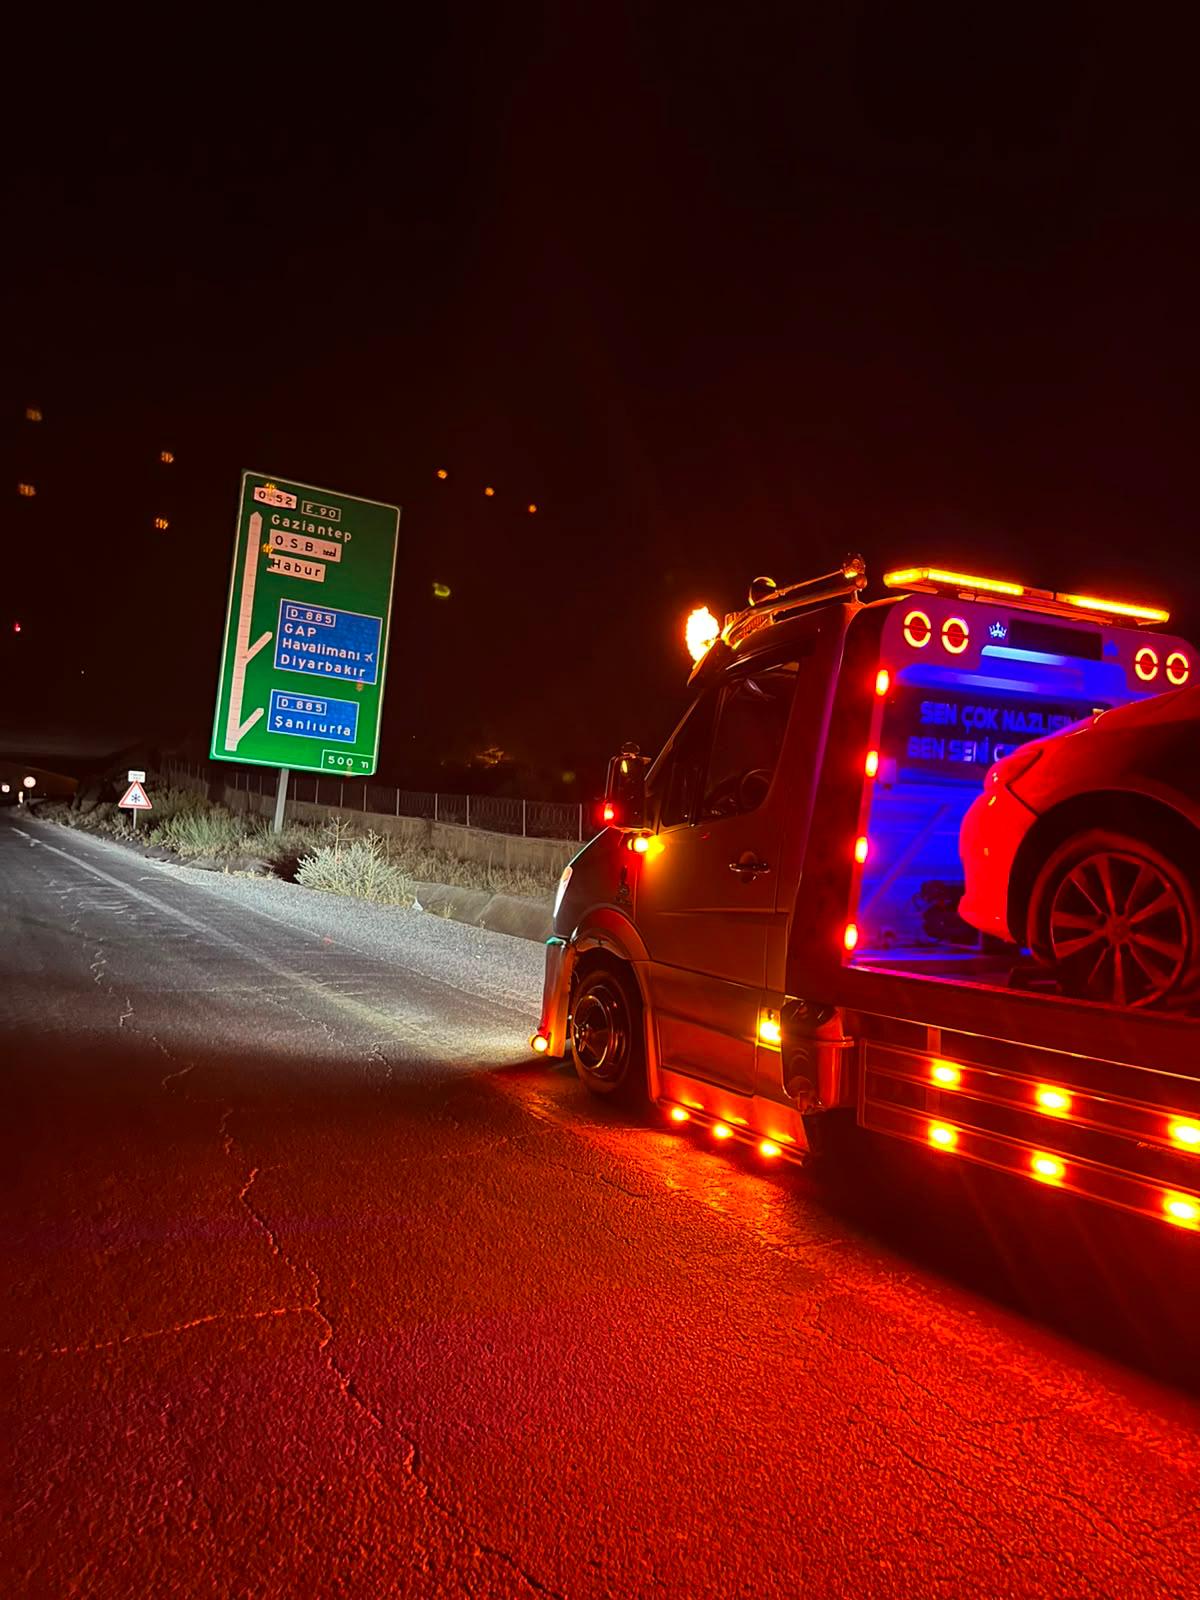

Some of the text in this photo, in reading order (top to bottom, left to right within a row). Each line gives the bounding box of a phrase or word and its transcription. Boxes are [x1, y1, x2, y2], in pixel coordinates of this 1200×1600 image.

[306, 504, 336, 518] E.90
[271, 514, 352, 543] Gaziantep
[275, 535, 318, 554] O.S.B.
[271, 558, 321, 577] Habur
[290, 609, 332, 624] D.885
[284, 623, 316, 638] GAP
[282, 638, 360, 661] Havalimanı
[280, 654, 366, 677] Diyarbakır
[281, 698, 323, 712] D.885
[275, 715, 351, 736] Şanlıurfa
[920, 701, 957, 725] SEN
[962, 705, 999, 733] ÇOK
[907, 736, 945, 761] BEN
[949, 736, 989, 763] SENİ
[328, 755, 354, 767] 500
